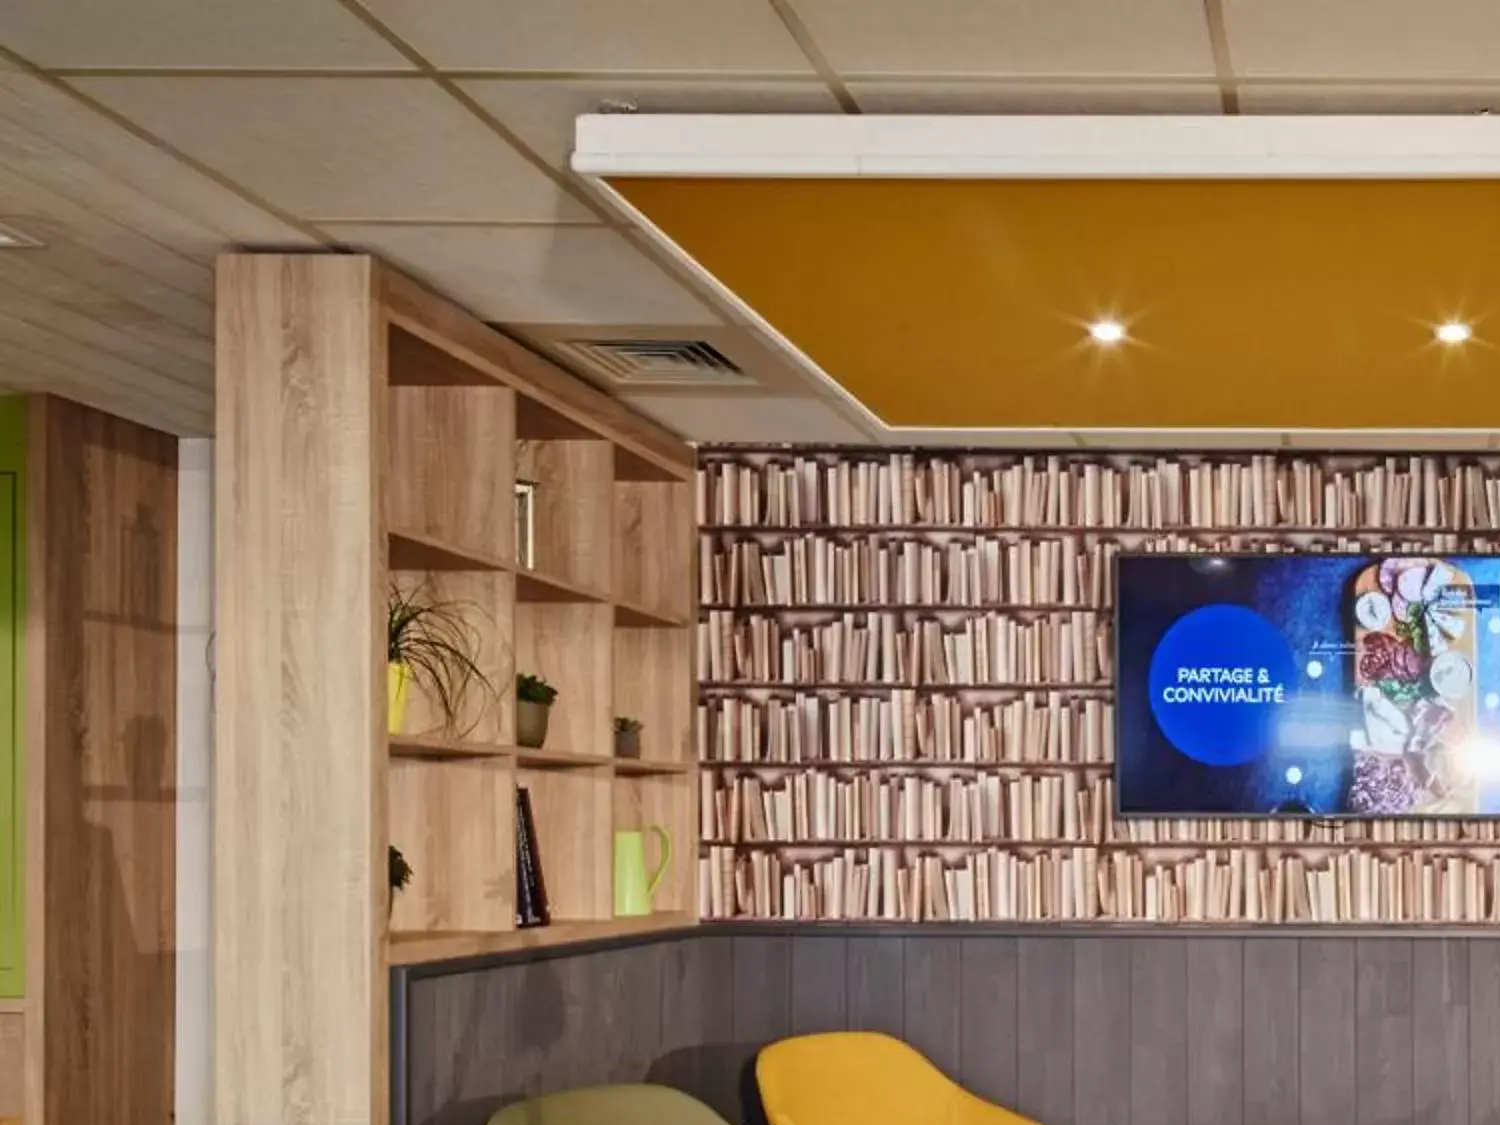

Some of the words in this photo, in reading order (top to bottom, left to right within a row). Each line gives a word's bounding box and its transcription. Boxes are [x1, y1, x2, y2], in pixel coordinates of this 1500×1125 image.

[1177, 667, 1253, 683] PARTAGE
[1257, 667, 1270, 683] &
[1163, 684, 1285, 703] CONVIVIALITÉ
